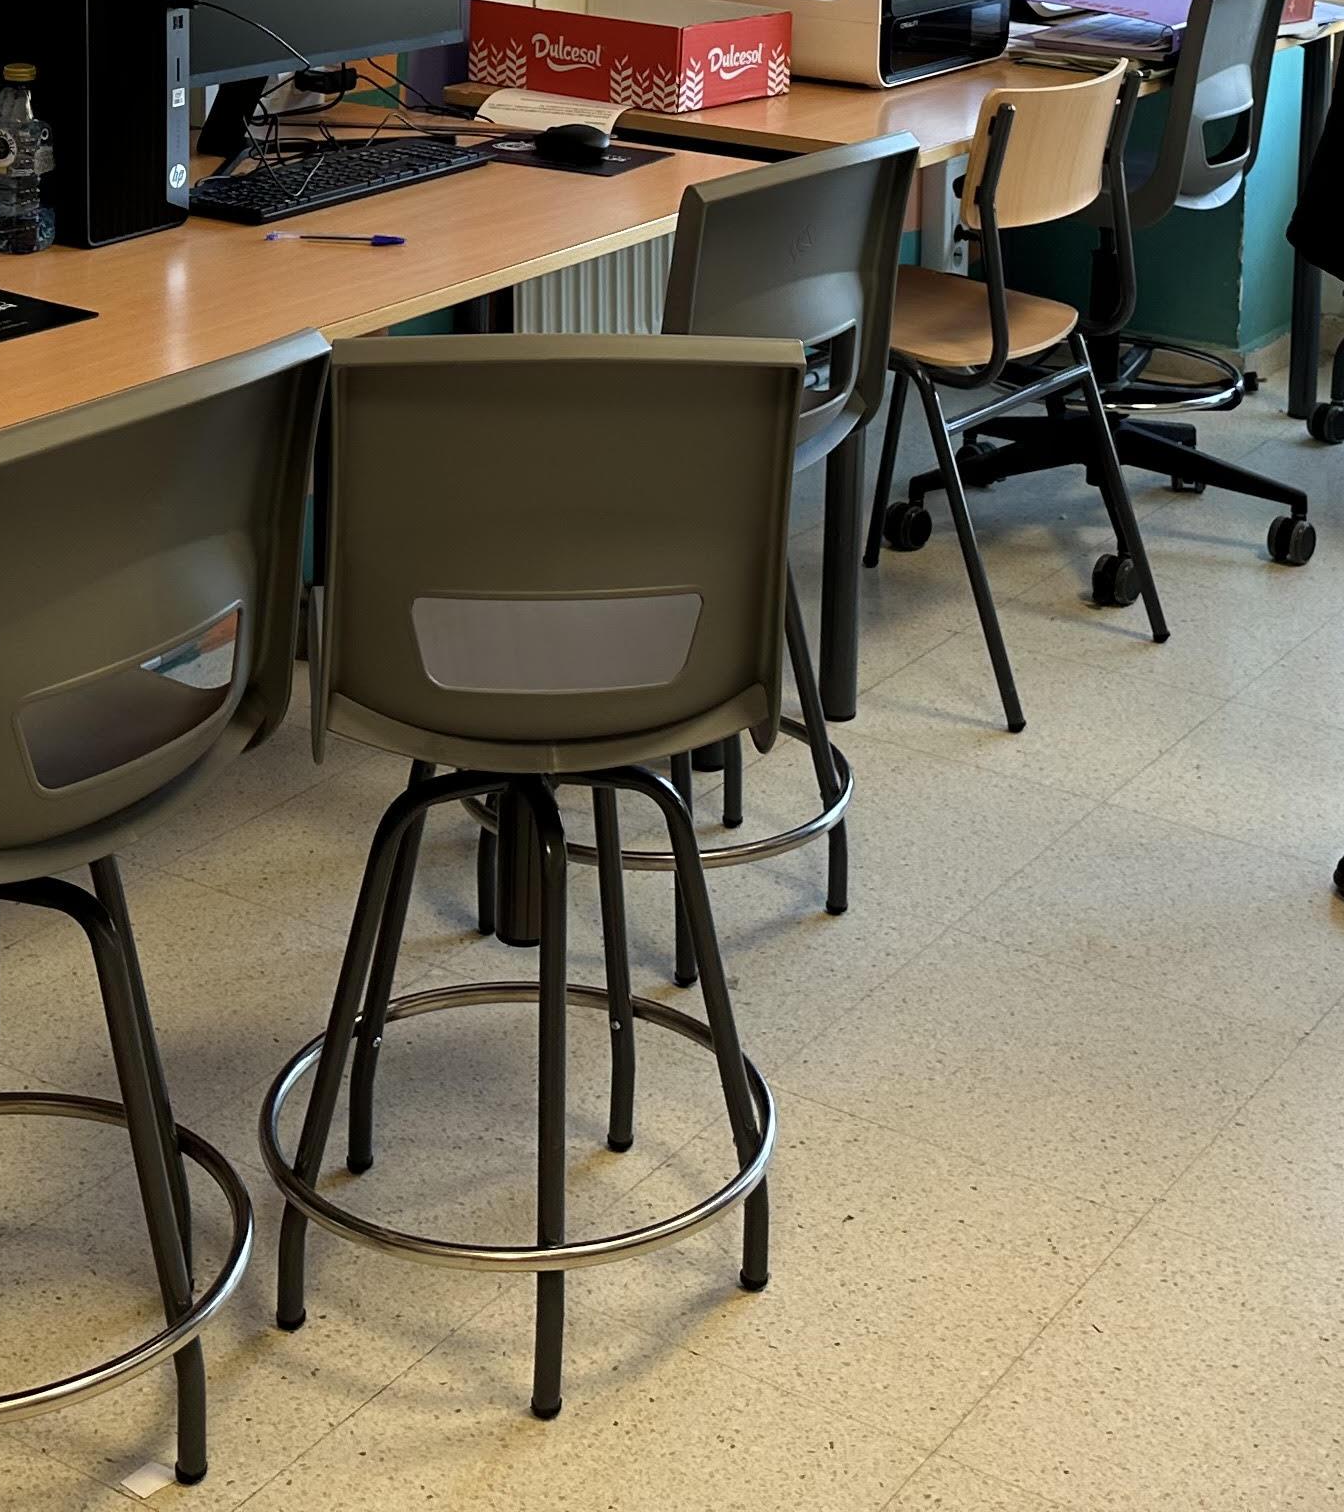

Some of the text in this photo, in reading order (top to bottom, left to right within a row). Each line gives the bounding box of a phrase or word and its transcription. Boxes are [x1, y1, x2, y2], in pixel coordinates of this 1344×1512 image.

[531, 32, 602, 67] Dulcesol
[707, 42, 763, 73] Dulcesol
[170, 164, 185, 188] hp
